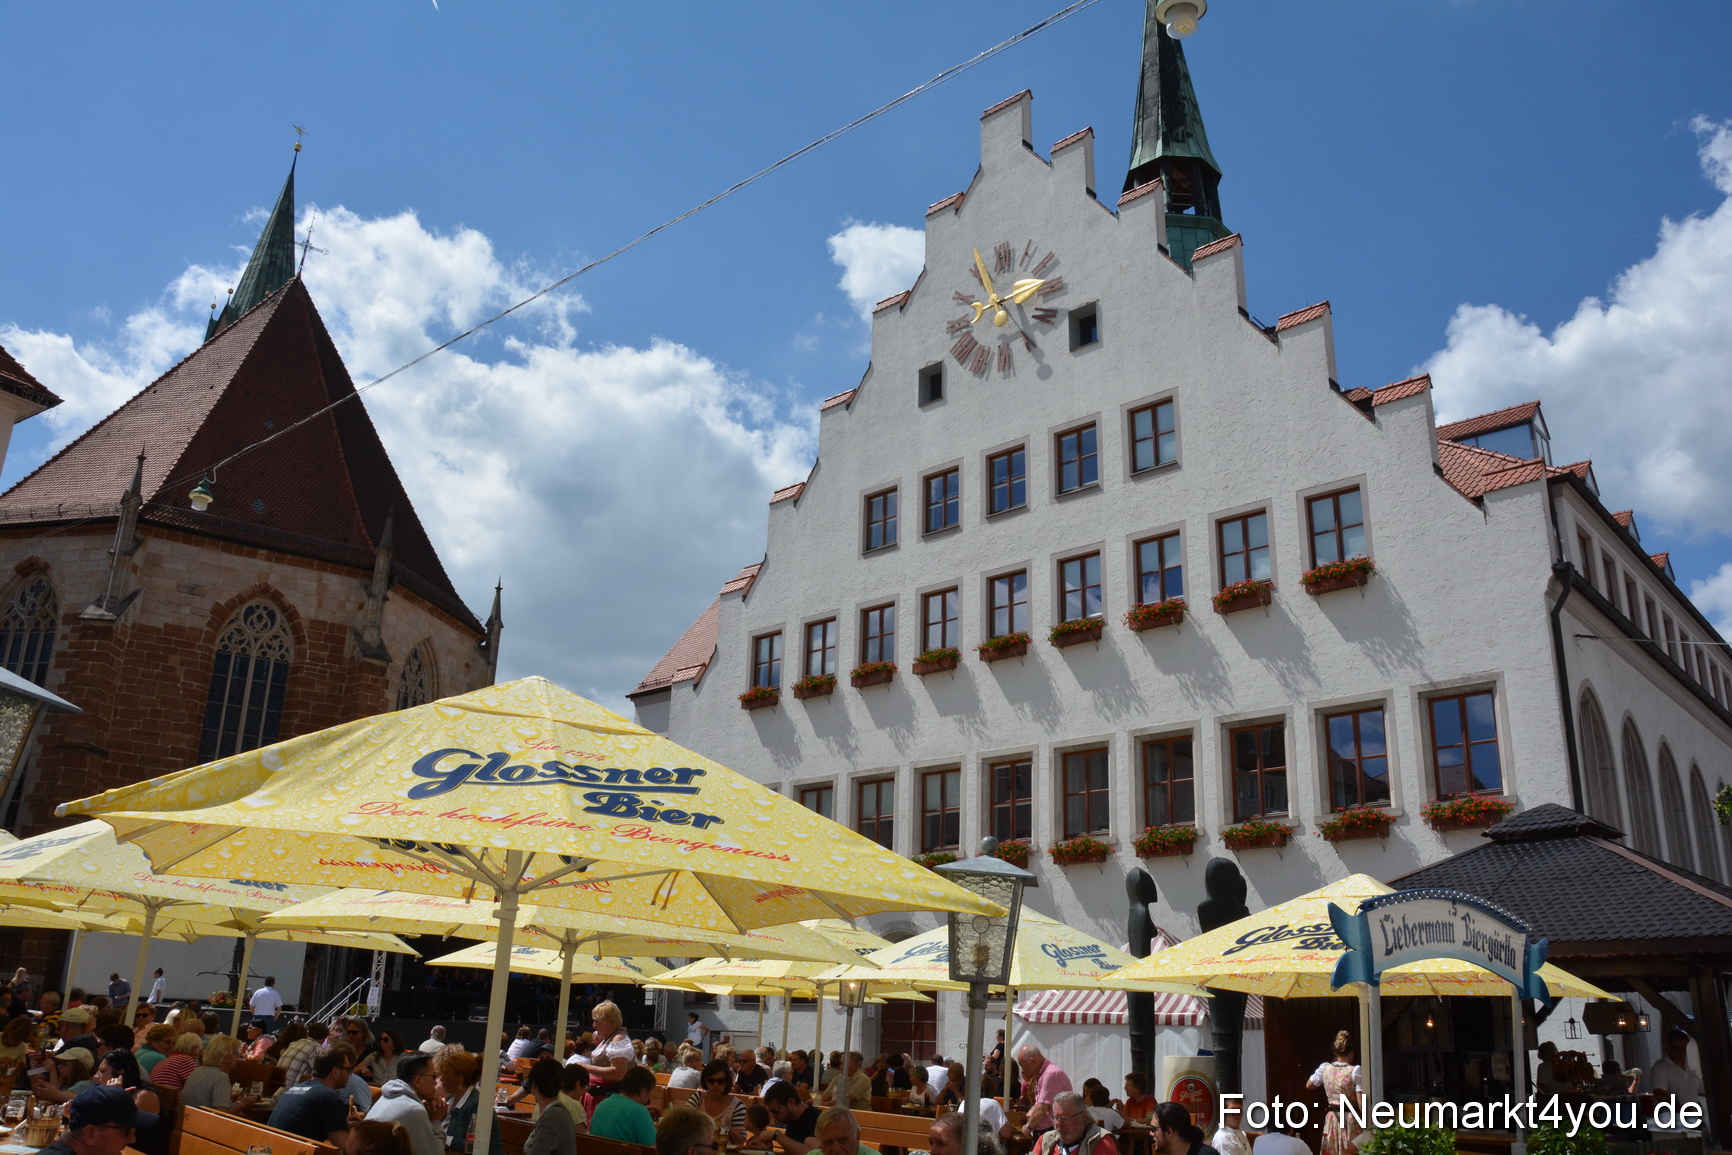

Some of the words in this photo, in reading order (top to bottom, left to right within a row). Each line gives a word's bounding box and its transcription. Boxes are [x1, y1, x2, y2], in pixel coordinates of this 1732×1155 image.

[518, 738, 561, 751] Seit
[407, 748, 707, 800] Glossner
[583, 791, 725, 830] Bier
[349, 801, 428, 816] Der
[437, 808, 594, 832] hochfeine
[610, 823, 791, 862] Biergenuss
[246, 889, 303, 904] Biergen
[1222, 923, 1336, 956] Gloss
[1292, 937, 1348, 951] Bie
